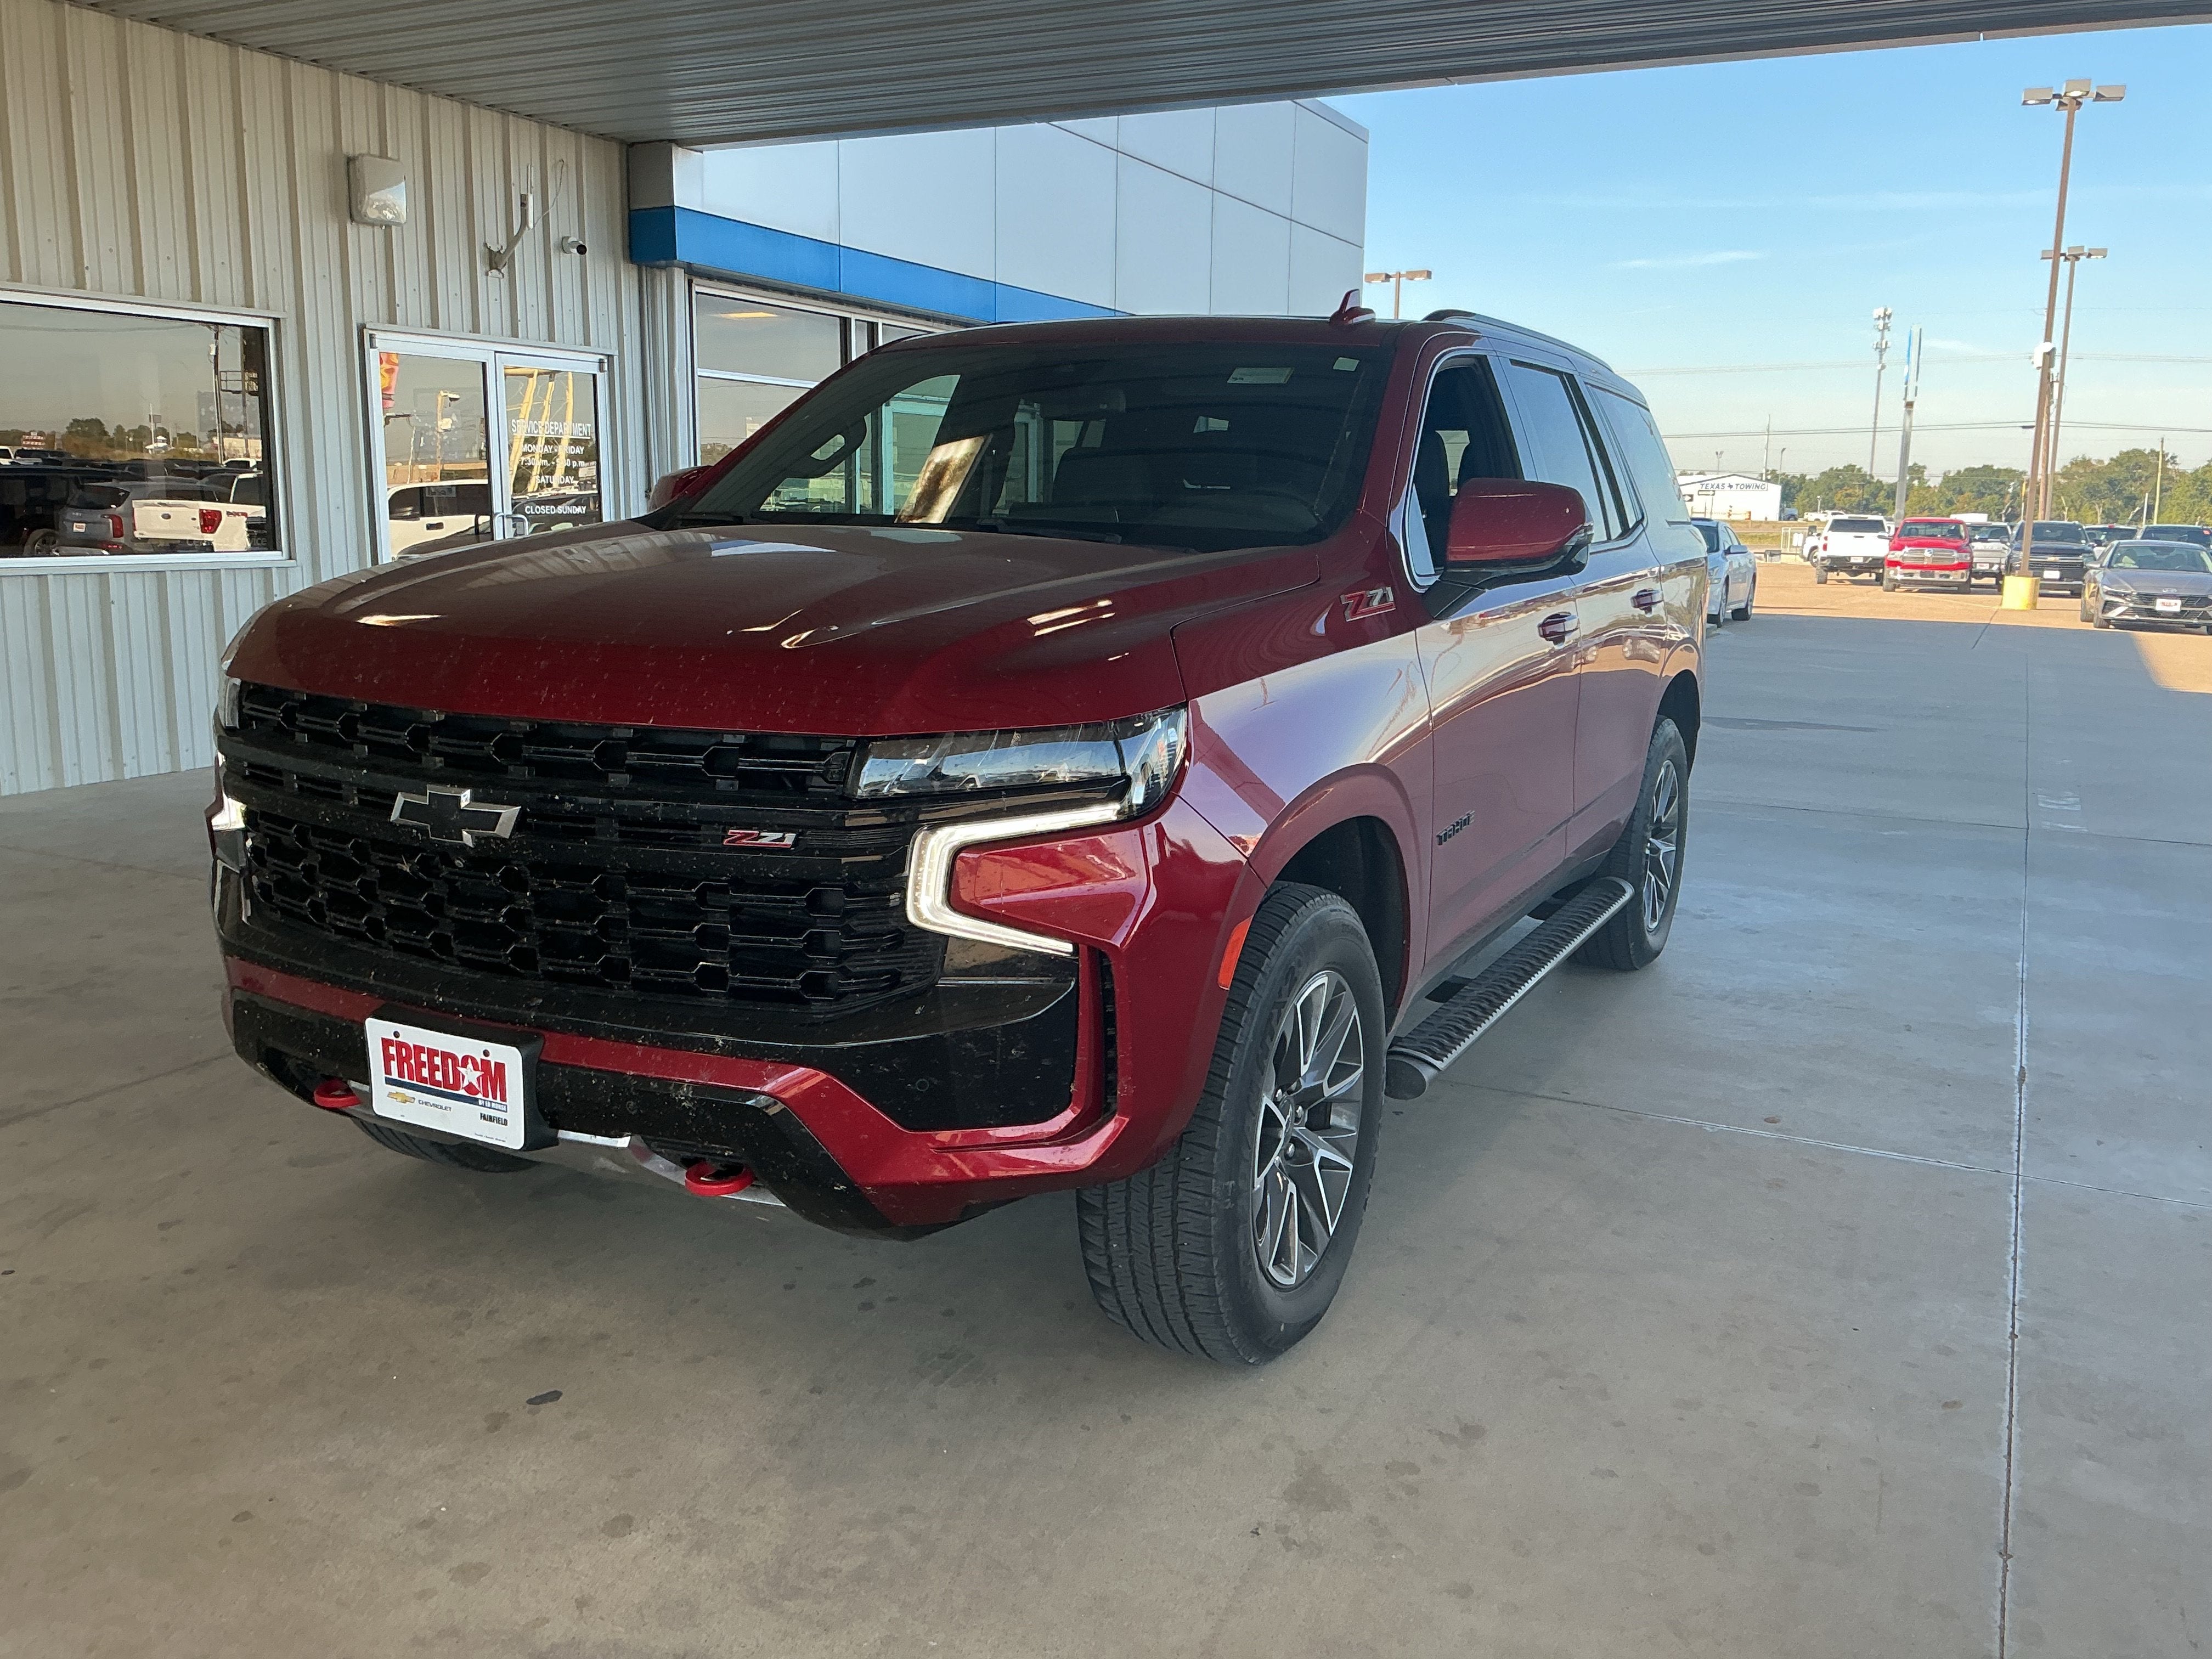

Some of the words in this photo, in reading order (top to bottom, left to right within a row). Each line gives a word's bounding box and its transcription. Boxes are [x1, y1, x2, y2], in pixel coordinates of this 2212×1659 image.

[511, 419, 544, 434] SERVICE
[522, 444, 553, 453] MONDAY
[536, 475, 574, 484] SATUDAY
[525, 505, 556, 514] CLOSED
[557, 505, 586, 515] SUNDAY
[1340, 586, 1396, 622] Z71
[723, 830, 797, 848] Z71
[381, 1037, 507, 1103] FREEDOM
[418, 1099, 452, 1111] CHEVROLET
[480, 1112, 508, 1126] FAIRFIELD
